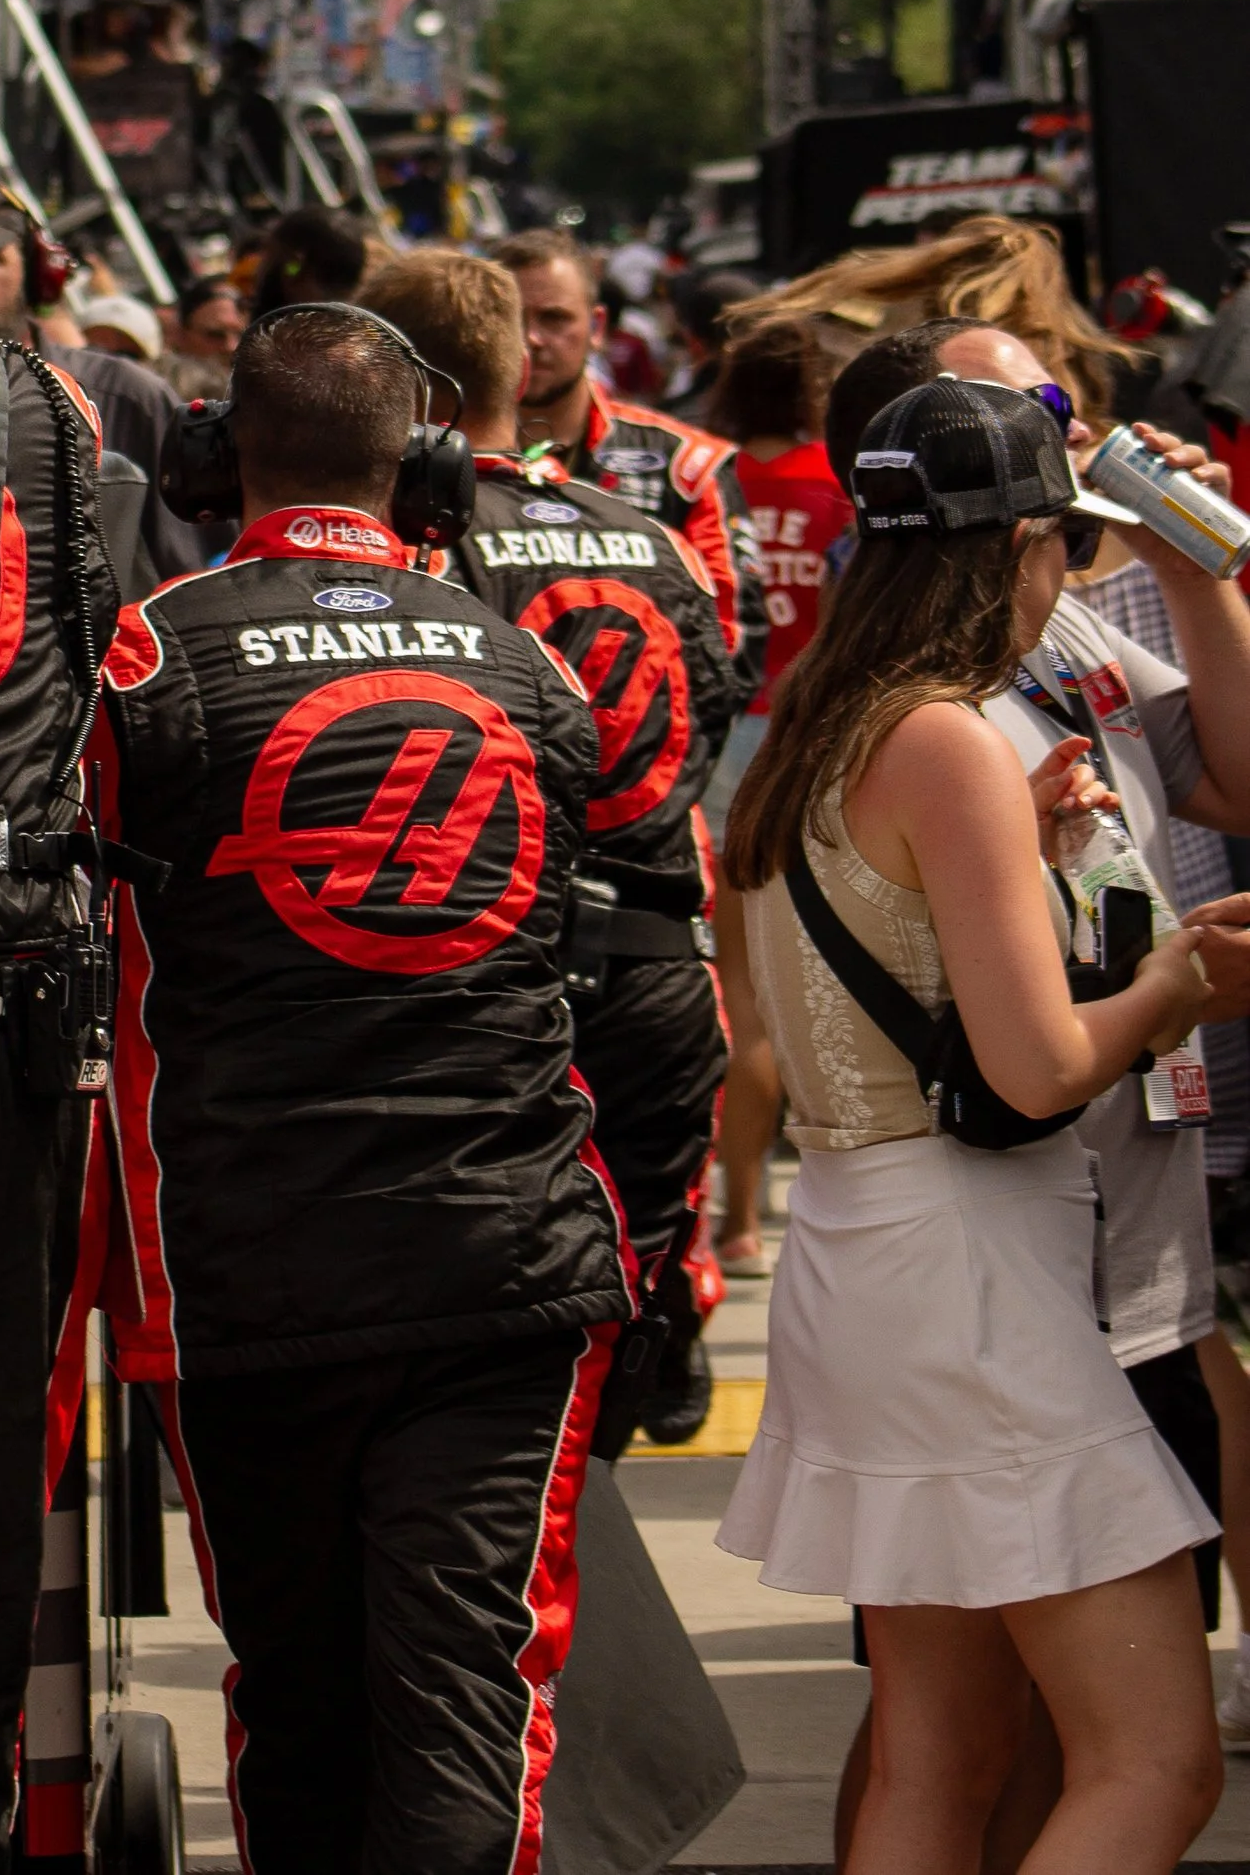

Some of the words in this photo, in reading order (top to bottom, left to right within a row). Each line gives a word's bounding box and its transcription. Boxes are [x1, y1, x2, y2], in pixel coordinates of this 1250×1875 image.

[886, 146, 1029, 190] TEAM
[326, 521, 390, 547] Haas
[900, 514, 929, 526] 2025
[474, 531, 658, 568] LEONARD
[237, 623, 484, 667] STANLEY
